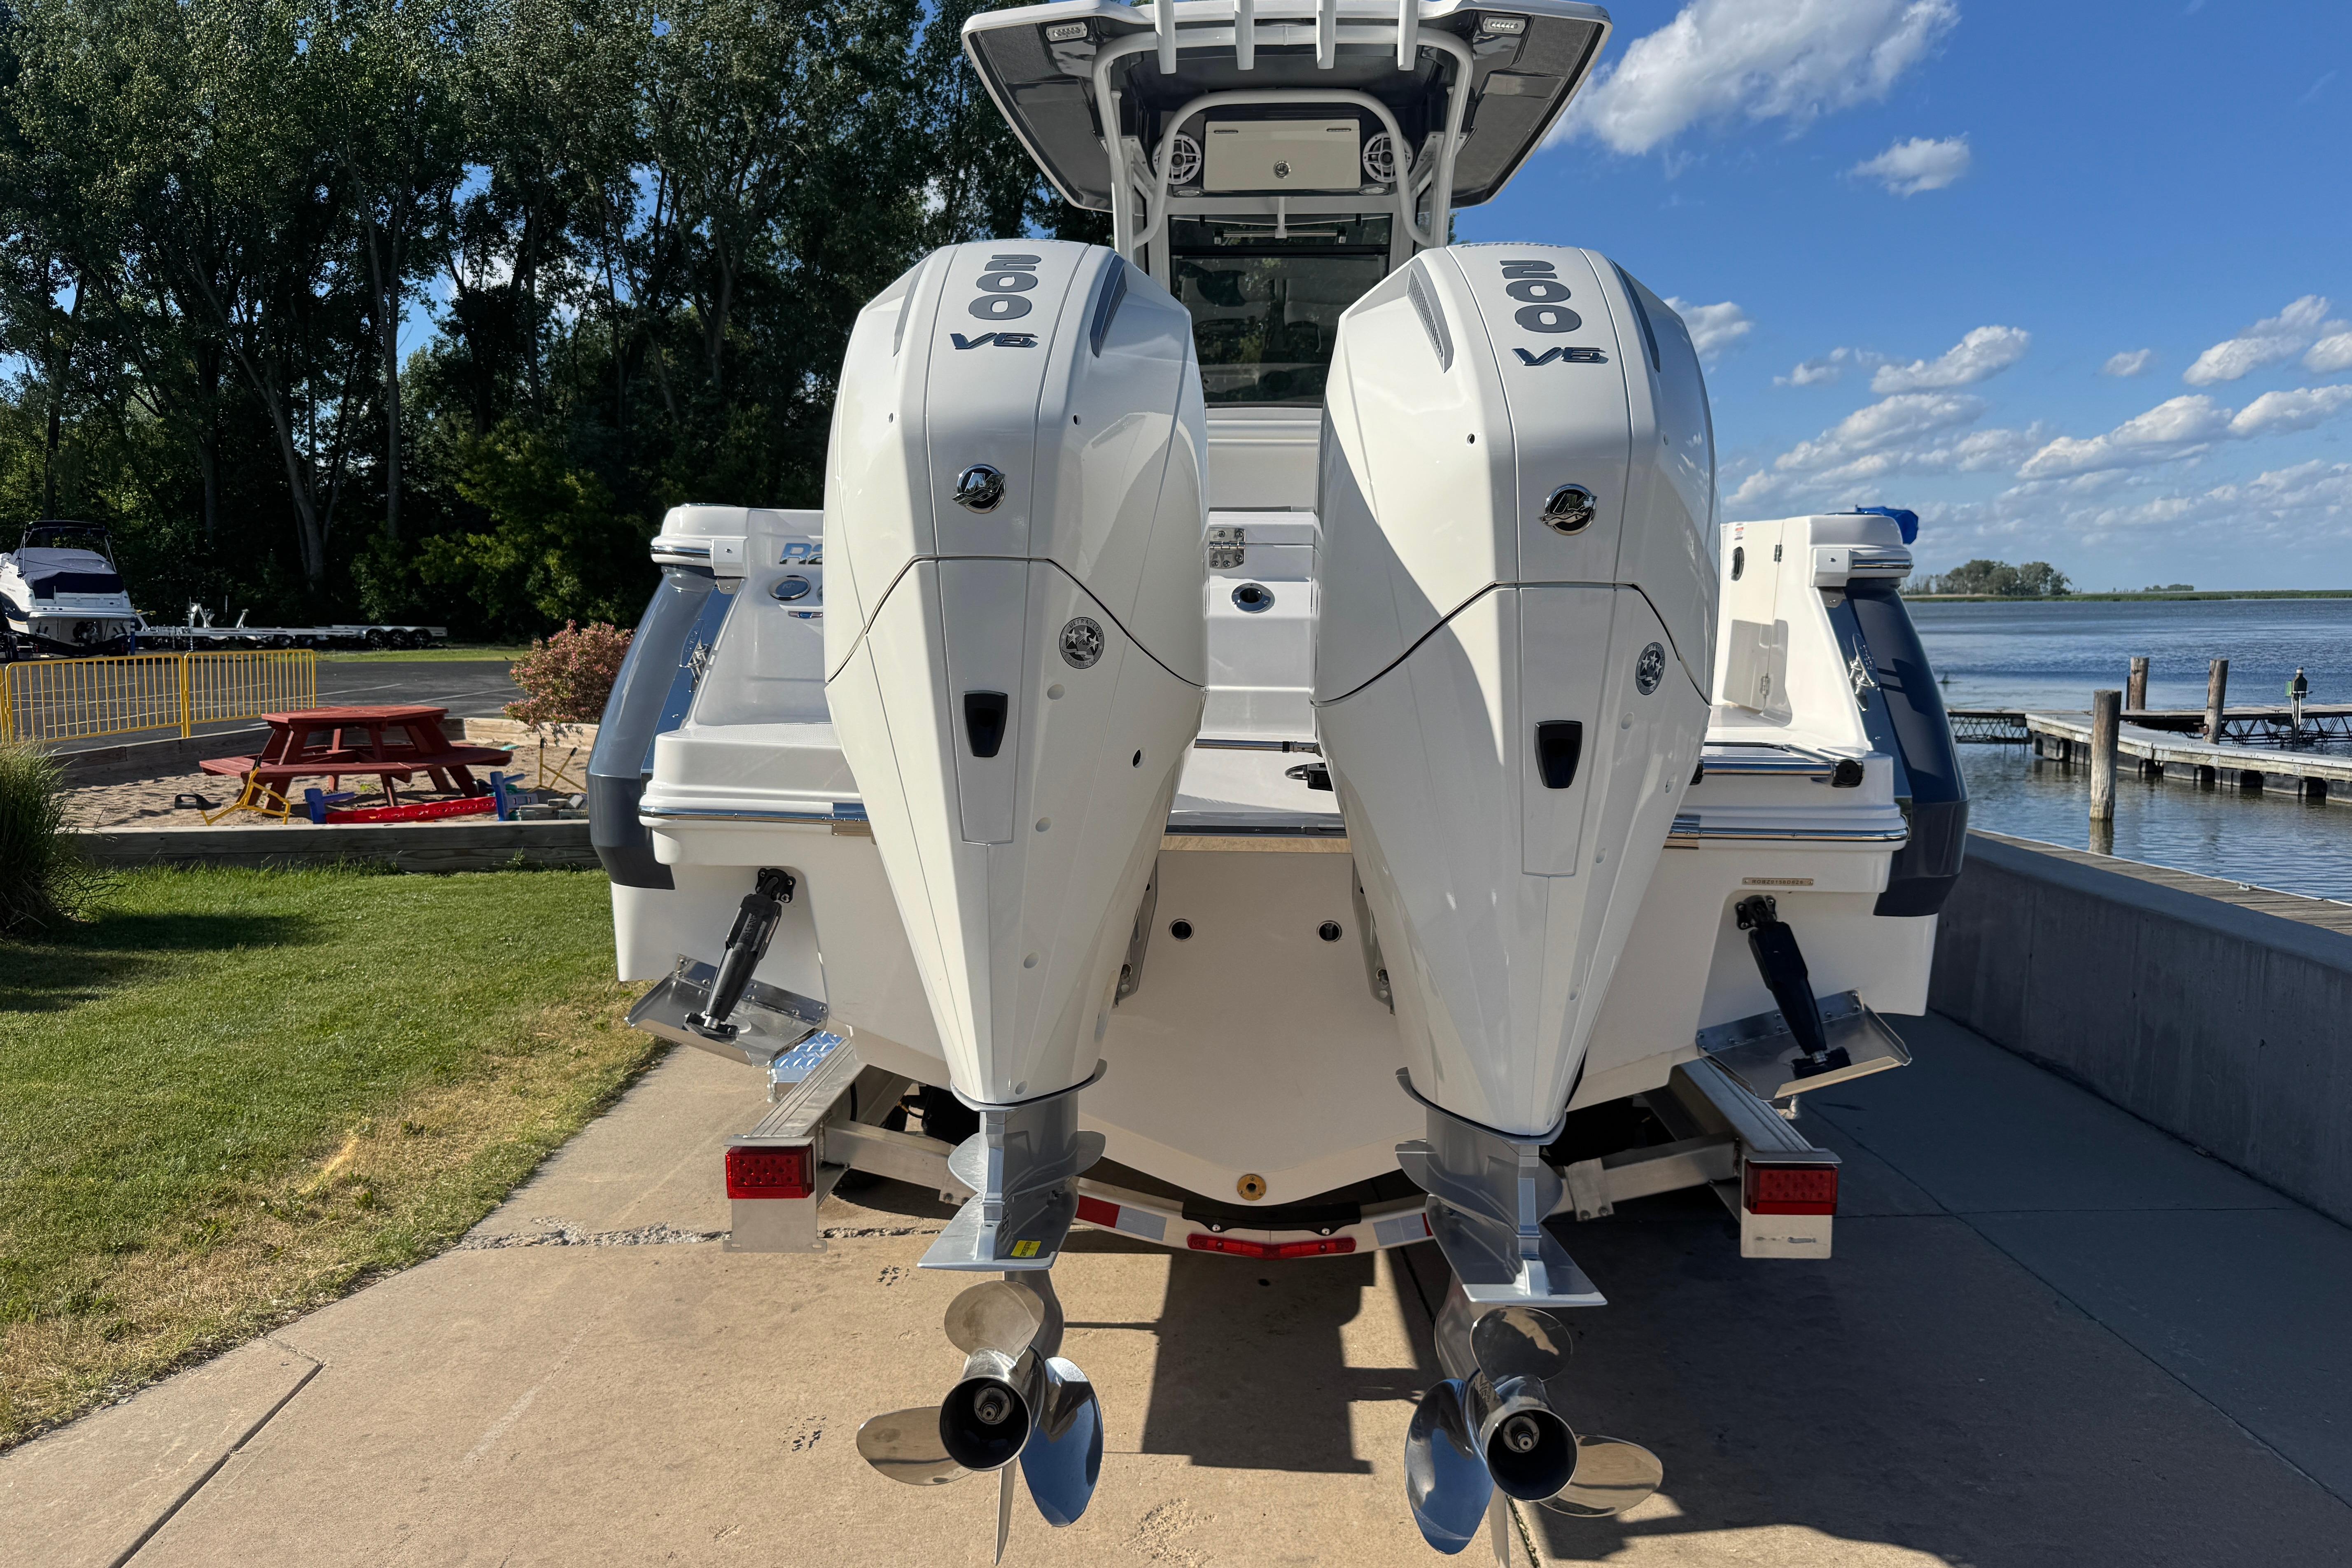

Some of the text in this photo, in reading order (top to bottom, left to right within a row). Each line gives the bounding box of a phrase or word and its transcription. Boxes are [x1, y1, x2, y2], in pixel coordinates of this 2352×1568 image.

[968, 254, 1042, 320] 200
[1500, 260, 1582, 333] 200
[950, 332, 1038, 350] V6
[1512, 347, 1606, 366] V6
[1069, 619, 1102, 637] ULTRA LOW
